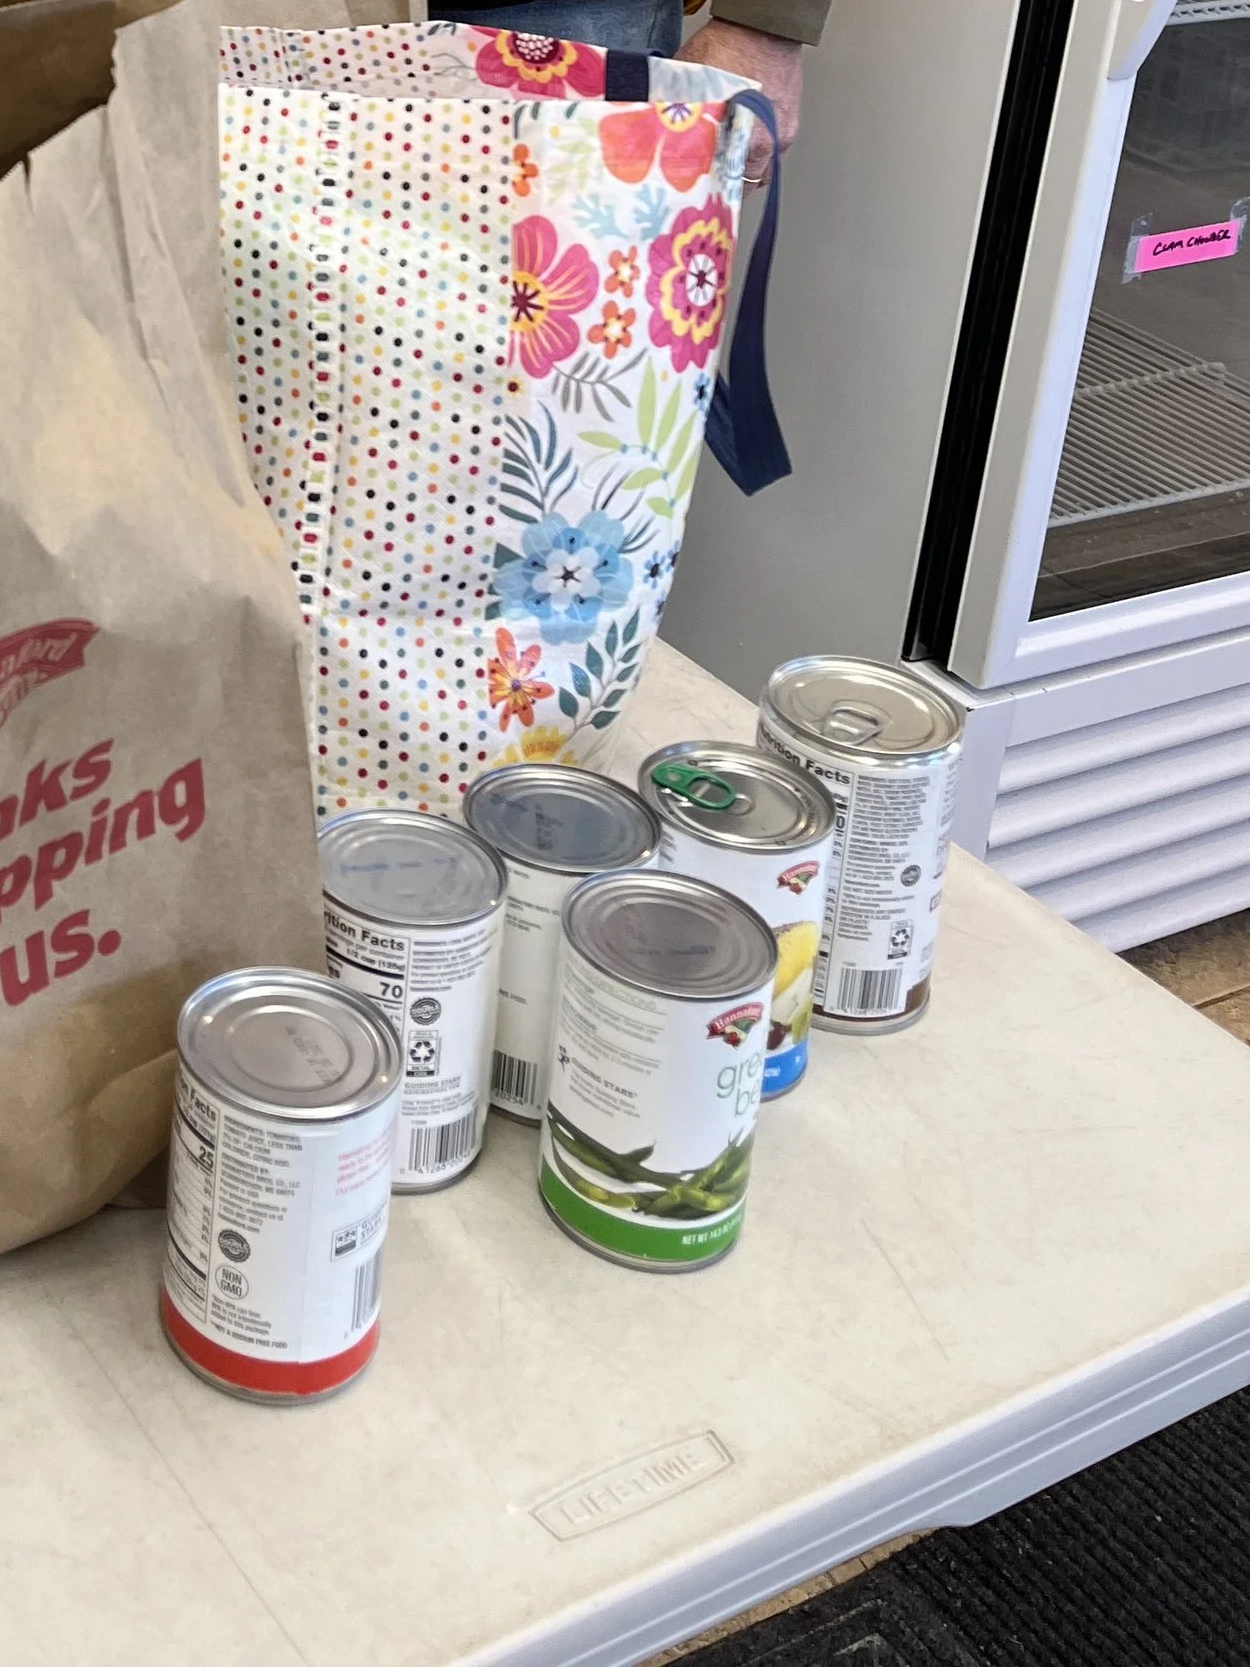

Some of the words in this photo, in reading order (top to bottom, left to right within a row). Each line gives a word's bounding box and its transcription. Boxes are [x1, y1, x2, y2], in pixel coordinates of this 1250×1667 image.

[1153, 240, 1183, 256] CLAM
[1187, 229, 1231, 247] CHOWDER
[805, 759, 851, 785] Facts
[361, 930, 405, 951] Facts
[379, 981, 404, 999] 70
[190, 1088, 216, 1122] Facts
[198, 1145, 214, 1169] 25
[682, 1234, 696, 1245] NET
[698, 1232, 709, 1243] WT
[222, 1268, 242, 1285] NON
[220, 1280, 242, 1297] GMO
